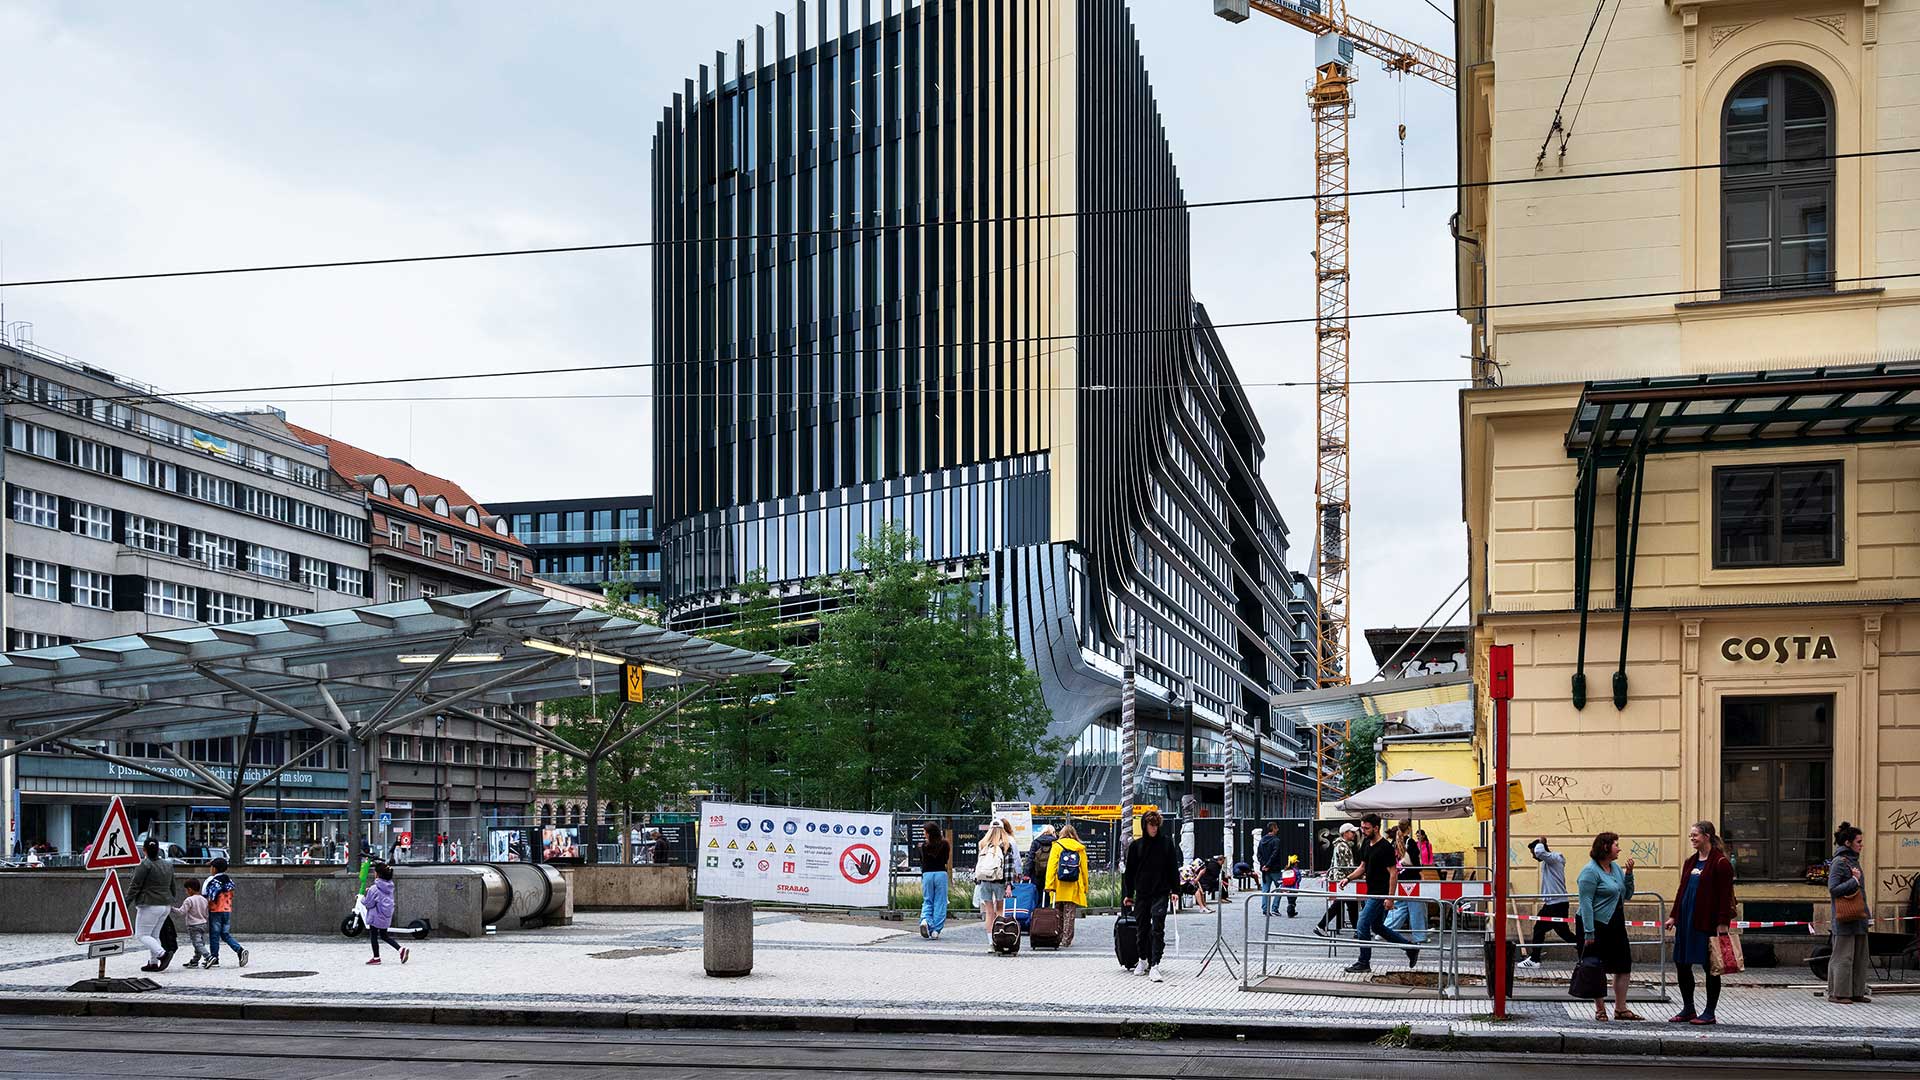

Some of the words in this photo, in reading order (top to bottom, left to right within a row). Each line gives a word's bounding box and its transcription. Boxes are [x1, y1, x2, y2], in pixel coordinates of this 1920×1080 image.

[1721, 636, 1837, 664] COSTA
[109, 762, 115, 774] k
[170, 768, 189, 777] slov
[294, 771, 313, 783] slova
